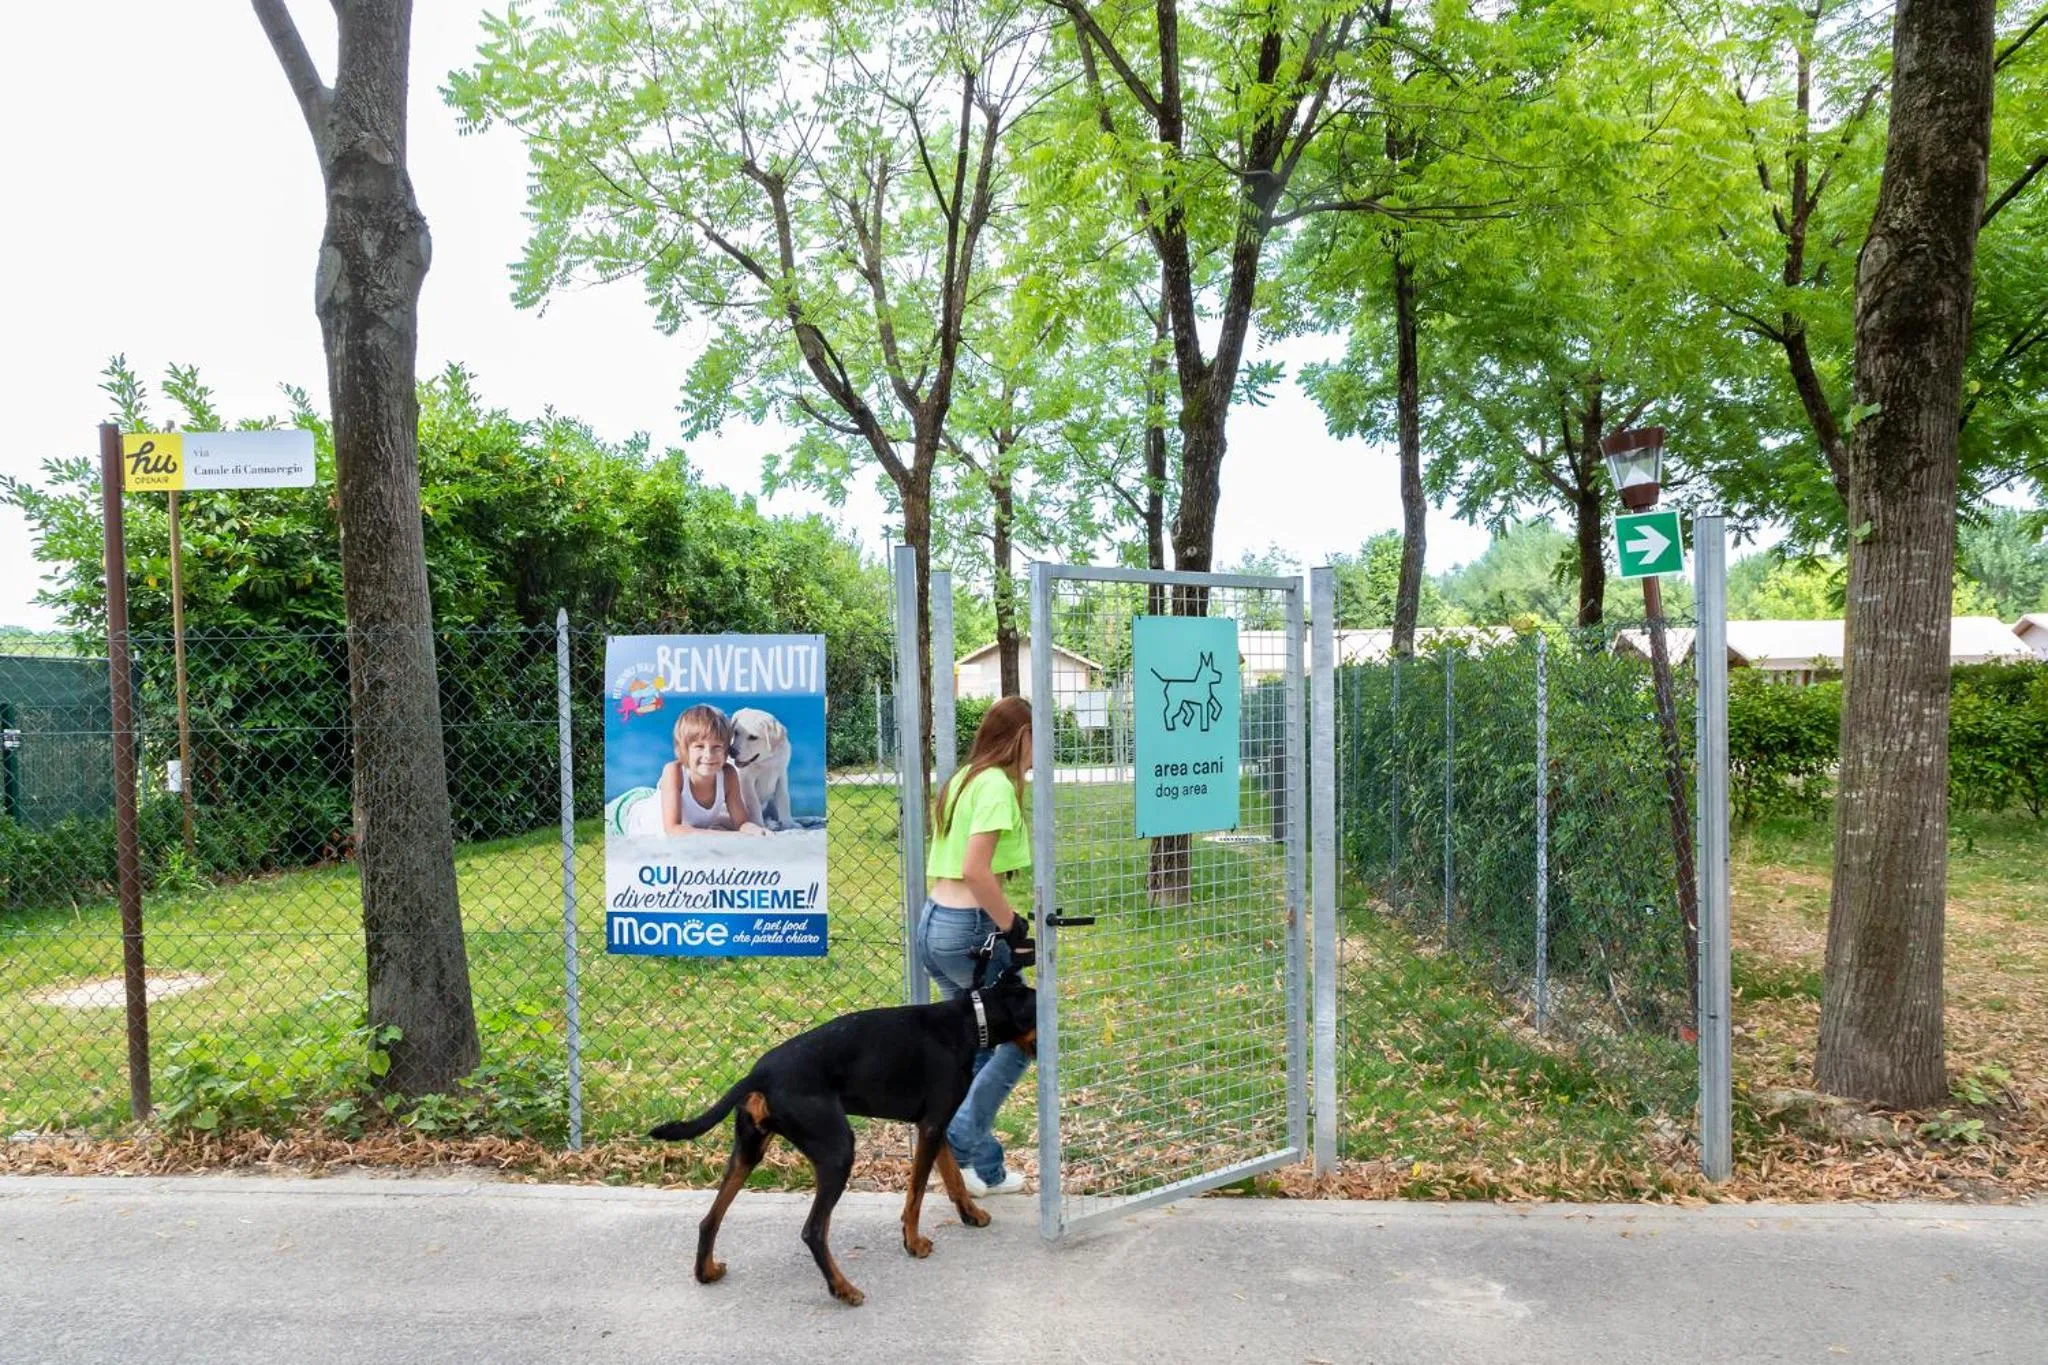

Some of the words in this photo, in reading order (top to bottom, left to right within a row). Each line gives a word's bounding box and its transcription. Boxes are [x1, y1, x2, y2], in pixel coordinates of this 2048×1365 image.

[126, 440, 177, 475] hu
[194, 464, 230, 475] Canale
[231, 464, 241, 474] di
[243, 463, 303, 476] Cannaregio
[134, 476, 170, 485] OPENAIR
[656, 644, 818, 693] BENVENUTI
[1154, 763, 1188, 778] area
[1192, 756, 1223, 775] cani
[1155, 784, 1179, 800] dog
[1182, 783, 1208, 796] area
[638, 866, 678, 887] QUI
[677, 867, 781, 892] possiamo
[613, 885, 713, 909] divertirci
[712, 882, 819, 909] INSIEME!!
[761, 919, 782, 934] pet
[781, 918, 809, 935] food
[732, 930, 752, 943] che
[750, 931, 784, 947] parla
[785, 931, 820, 943] chiaro
